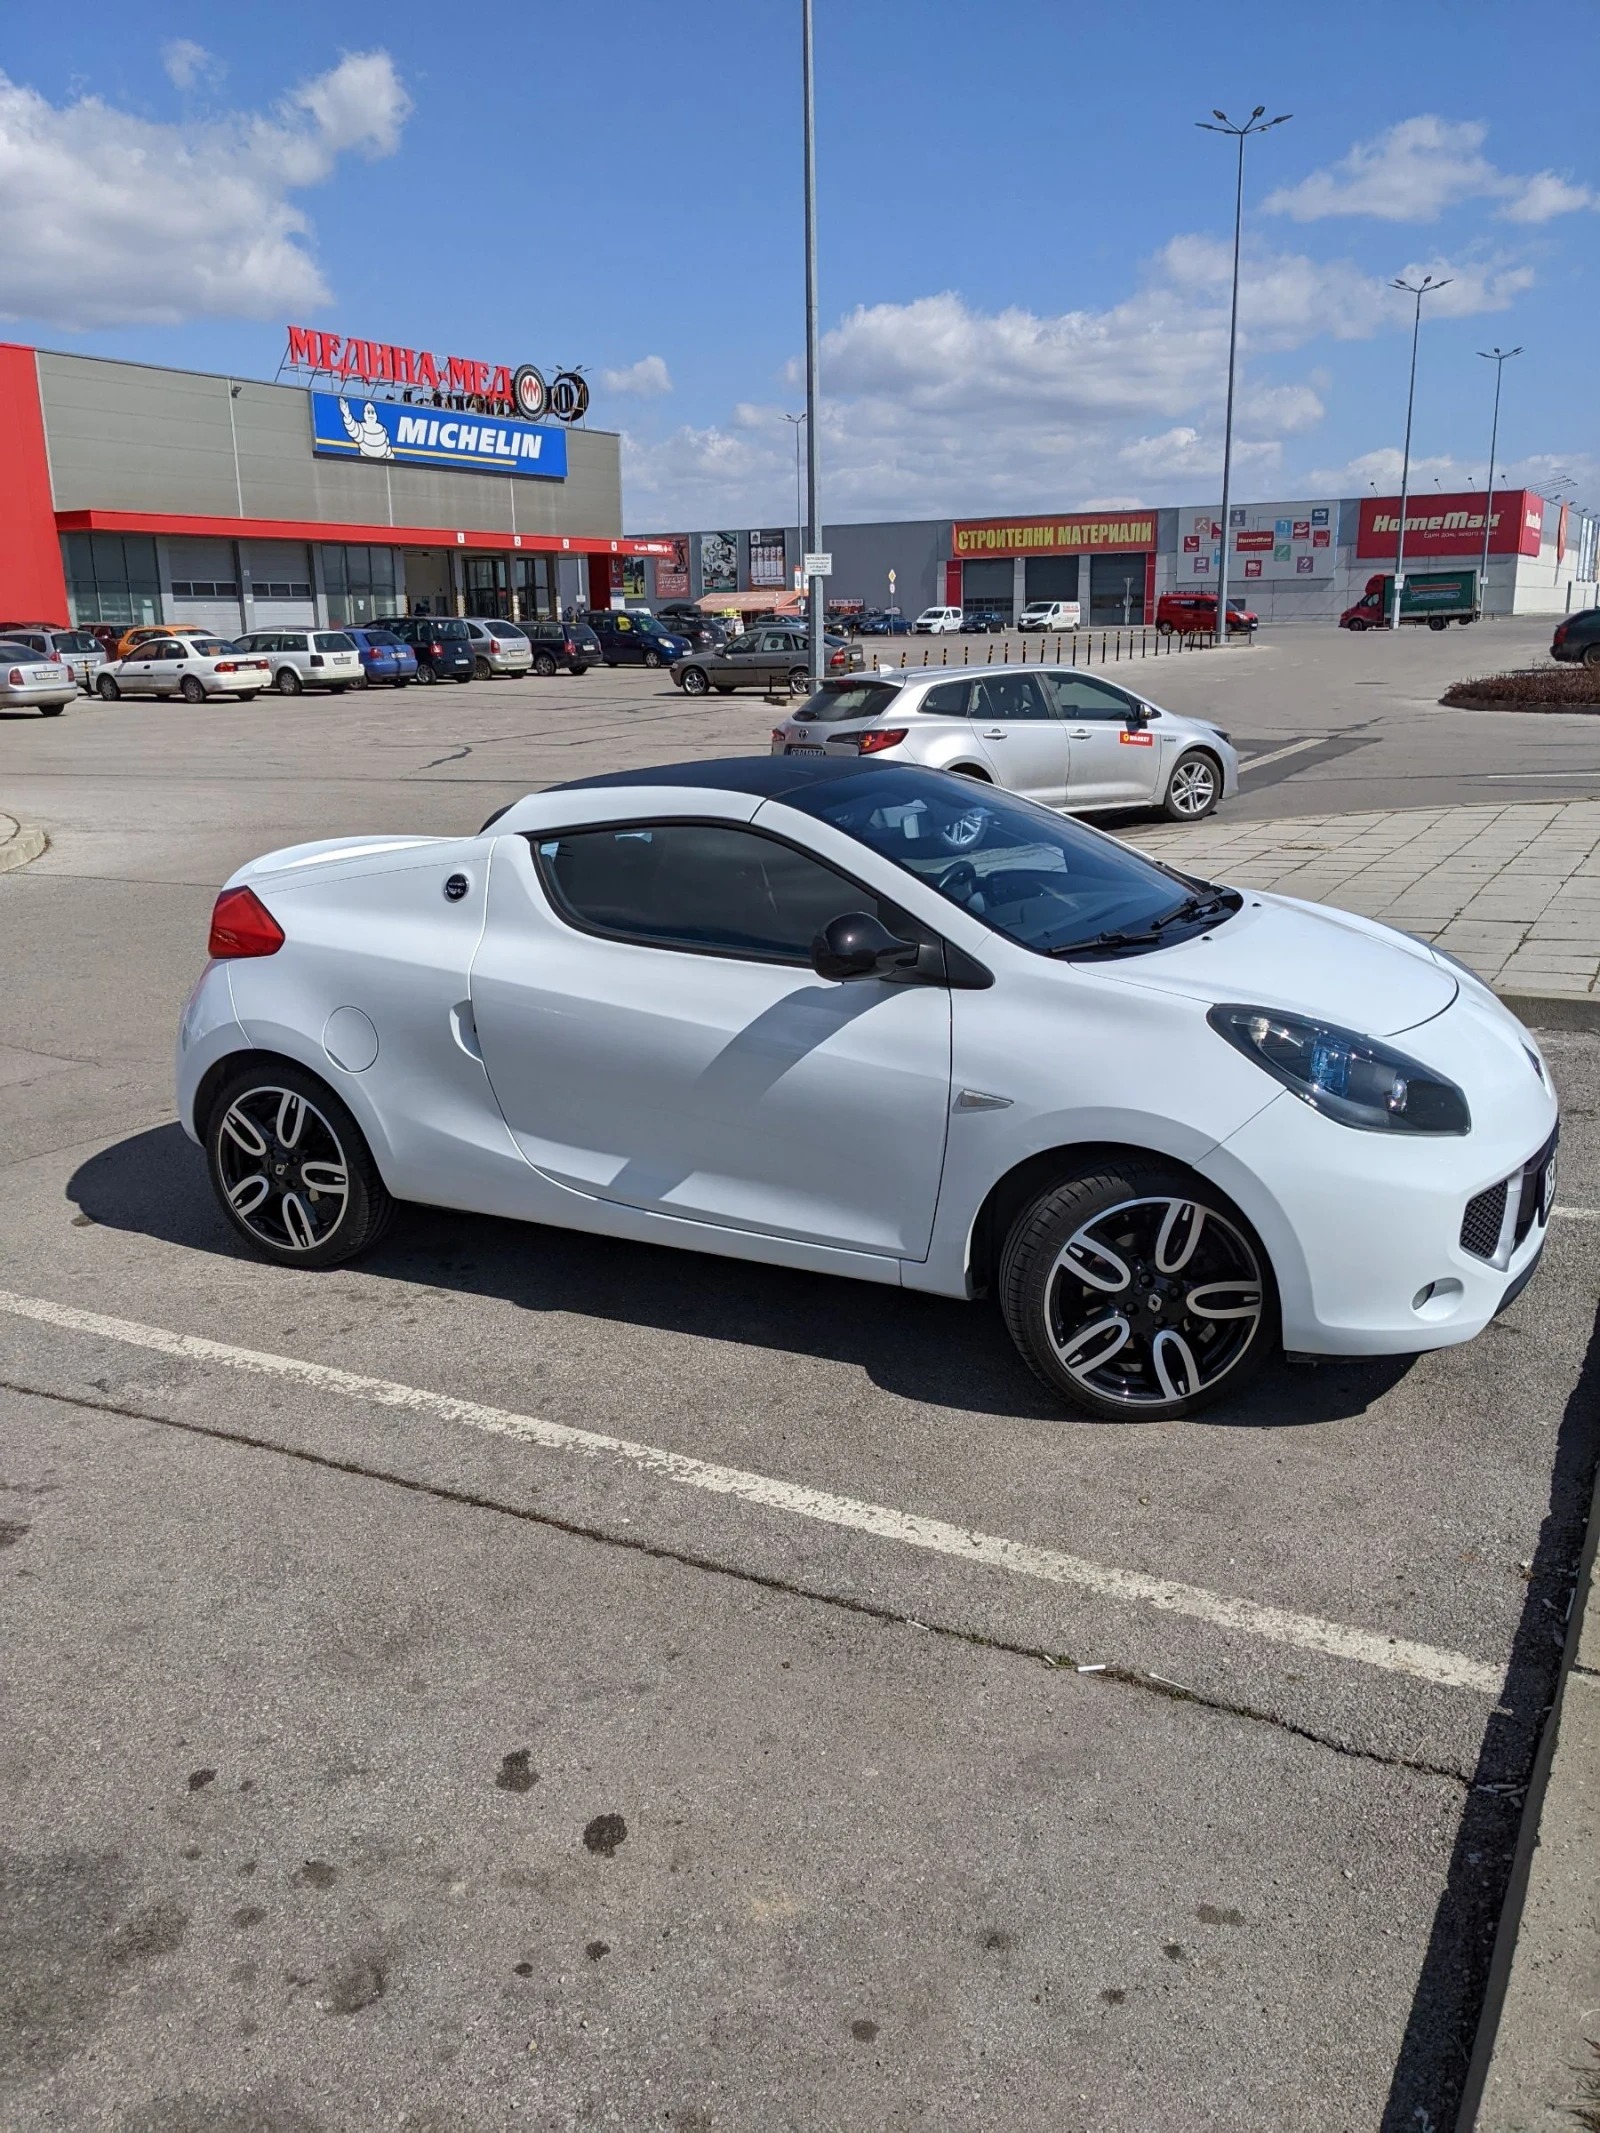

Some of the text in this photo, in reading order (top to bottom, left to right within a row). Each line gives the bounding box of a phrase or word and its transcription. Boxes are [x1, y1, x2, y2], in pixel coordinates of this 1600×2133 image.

[287, 325, 515, 408] МЕДИНА-МЕД
[397, 416, 543, 459] MICHELIN
[958, 522, 1152, 550] СТРОИТЕЛНИ МАТЕРИАЛИ
[1372, 511, 1501, 532] HomeMax
